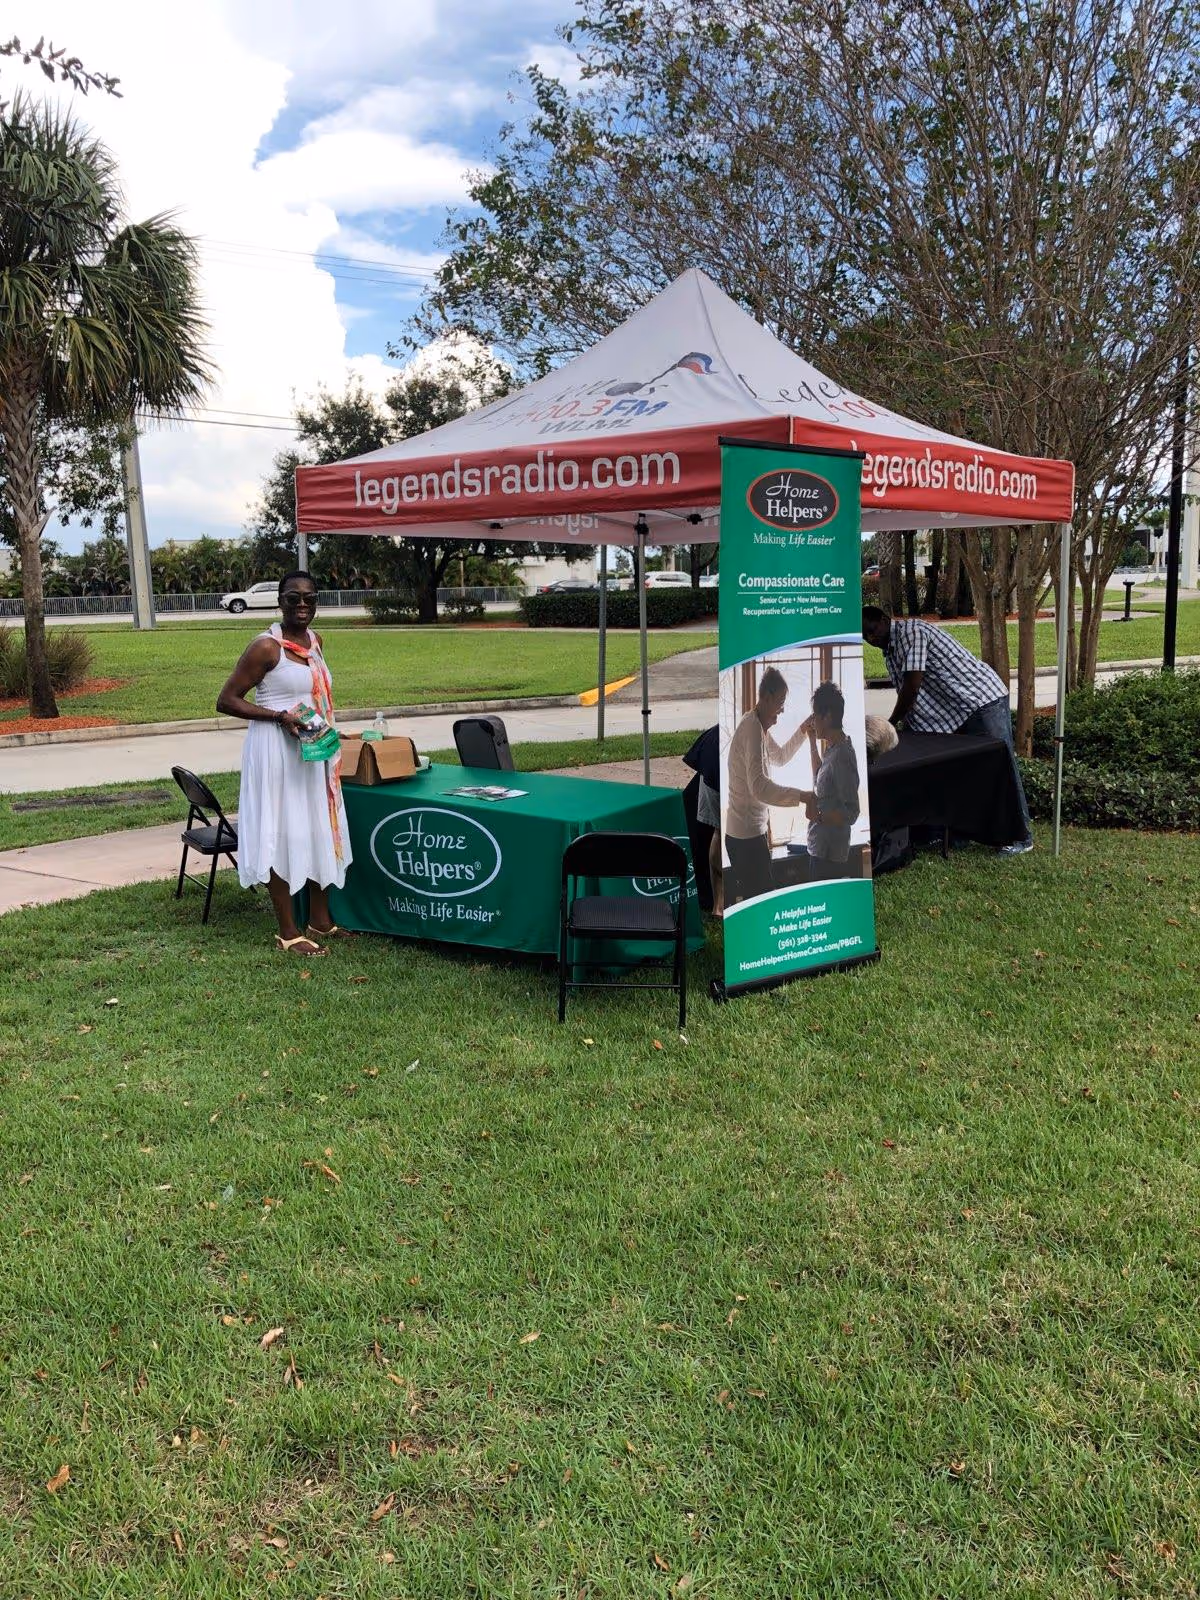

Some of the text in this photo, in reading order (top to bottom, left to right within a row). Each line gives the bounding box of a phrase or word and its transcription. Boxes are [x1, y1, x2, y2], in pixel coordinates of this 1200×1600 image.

[355, 450, 680, 515] legendsradio.com
[766, 473, 820, 498] Home
[753, 533, 786, 548] Making
[789, 533, 806, 547] Life
[738, 573, 845, 591] Compassionate Care
[760, 595, 777, 604] Senior
[778, 596, 792, 604] Care
[797, 595, 809, 603] New
[743, 605, 842, 616] Recuperative Care Long Term Care
[393, 813, 468, 849] Home
[388, 896, 428, 920] Making
[430, 902, 453, 921] Life
[774, 902, 826, 921] A Helpful Hand
[769, 916, 832, 935] To Make Life Easier
[778, 937, 796, 950] (561)
[740, 936, 863, 971] HomeHelpersHomeCare.com/PBGFL
